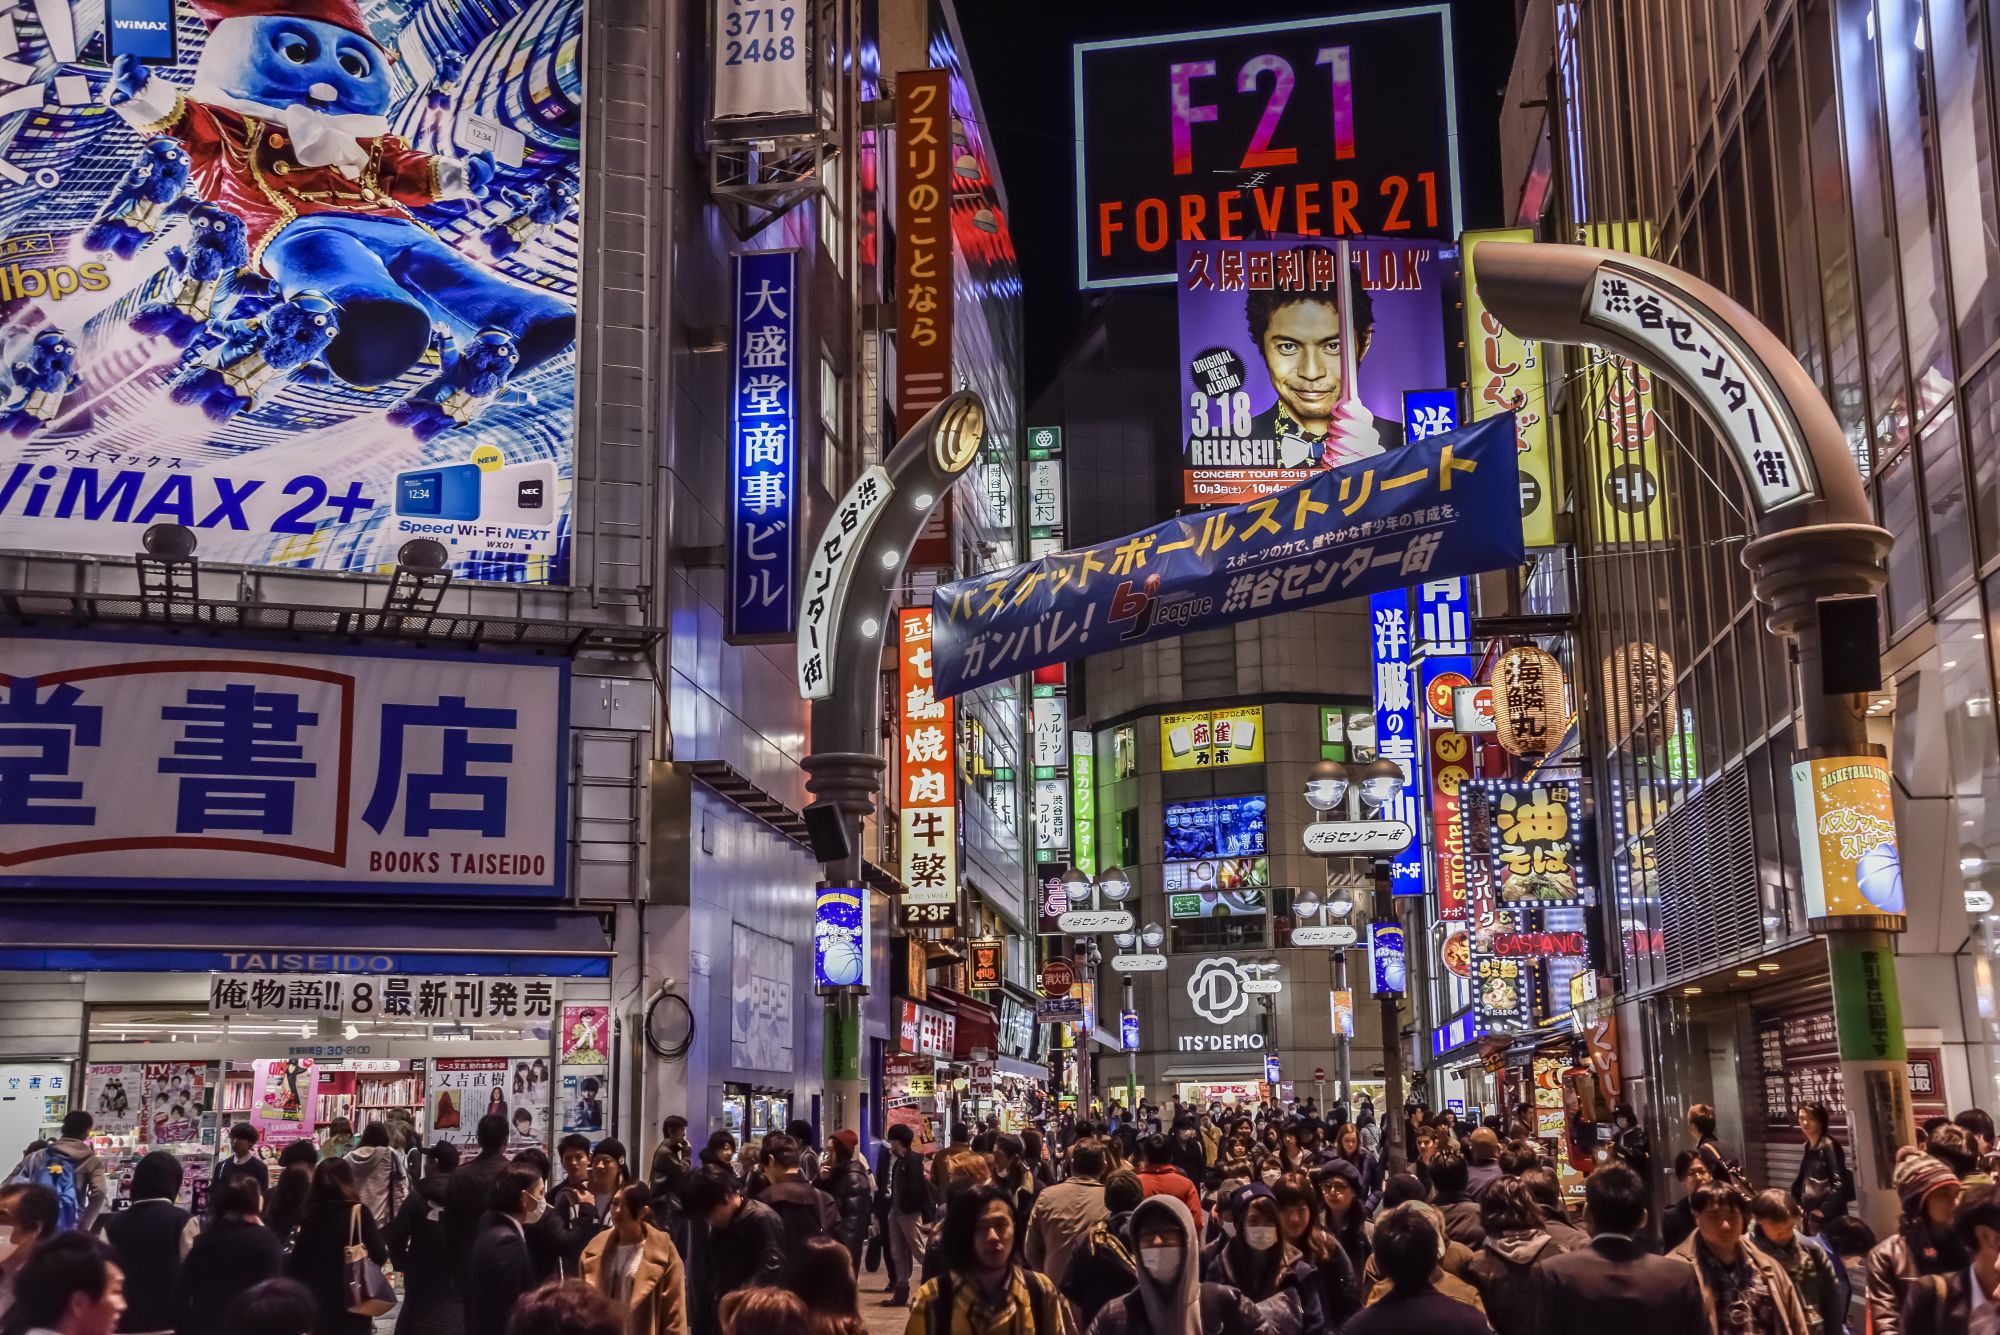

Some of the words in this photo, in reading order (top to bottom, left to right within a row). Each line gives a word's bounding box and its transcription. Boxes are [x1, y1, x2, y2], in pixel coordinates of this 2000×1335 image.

[115, 17, 168, 32] WiMAX
[725, 7, 796, 36] 3719
[725, 35, 796, 66] 2468
[1170, 45, 1355, 176] F21
[907, 84, 940, 348] クスリのことなら
[1099, 179, 1363, 257] FOREVER
[1379, 171, 1438, 232] 21
[1187, 249, 1337, 292] 久保田利伸
[1192, 350, 1235, 374] ORIGINAL
[1206, 366, 1230, 382] NEW
[1205, 375, 1242, 397] ALBUM!
[1601, 278, 1791, 488] 渋谷センター街
[1190, 391, 1252, 438] 3.18
[64, 449, 183, 470] ワイマックス
[477, 455, 498, 464] NEW
[741, 279, 788, 610] 大盛堂商事ビル
[1191, 439, 1275, 466] RELEASE!!
[1192, 471, 1246, 479] CONCERT
[1248, 470, 1279, 479] TOUR
[1280, 470, 1307, 478] 2015
[269, 473, 376, 536] 2+
[408, 489, 430, 499] 12:34
[521, 487, 540, 495] NEC
[1035, 464, 1056, 522] 渋谷西村
[397, 520, 454, 535] Speed
[457, 524, 502, 538] Wi-Fi
[505, 527, 551, 541] NEXT
[948, 444, 1479, 624] バスケットボールストリート
[1226, 503, 1461, 570] スポーツの力で、健やかな青少年の育成を。
[802, 476, 879, 691] 渋谷センター街
[1220, 530, 1444, 614] 渋谷センター街
[1151, 596, 1213, 628] league
[905, 646, 948, 803] 七輪焼肉
[1051, 713, 1062, 754] フルーツ
[1193, 721, 1231, 745] 麻雀
[0, 677, 517, 838] 堂書店
[1196, 749, 1230, 765] カボ
[1821, 764, 1874, 791] BASKETBALL
[1040, 804, 1051, 844] フルーツ
[1053, 795, 1064, 837] 渋谷西村
[1078, 776, 1092, 870] カワノ・クォーク
[1496, 788, 1569, 845] 油
[910, 811, 948, 889] 牛繁
[1308, 828, 1406, 844] 渋谷センター街
[369, 850, 440, 873] BOOKS
[450, 852, 546, 877] TAISEIDO
[1498, 841, 1572, 876] そば
[1166, 880, 1182, 891] 3F
[1472, 859, 1495, 928] ハンバーグ
[222, 952, 394, 973] TAISEIDO
[1044, 972, 1071, 986] 消火栓
[1049, 1000, 1081, 1012] セキネ
[437, 1072, 506, 1088] 又吉直樹
[969, 1062, 993, 1077] Tax
[969, 1079, 993, 1093] Free
